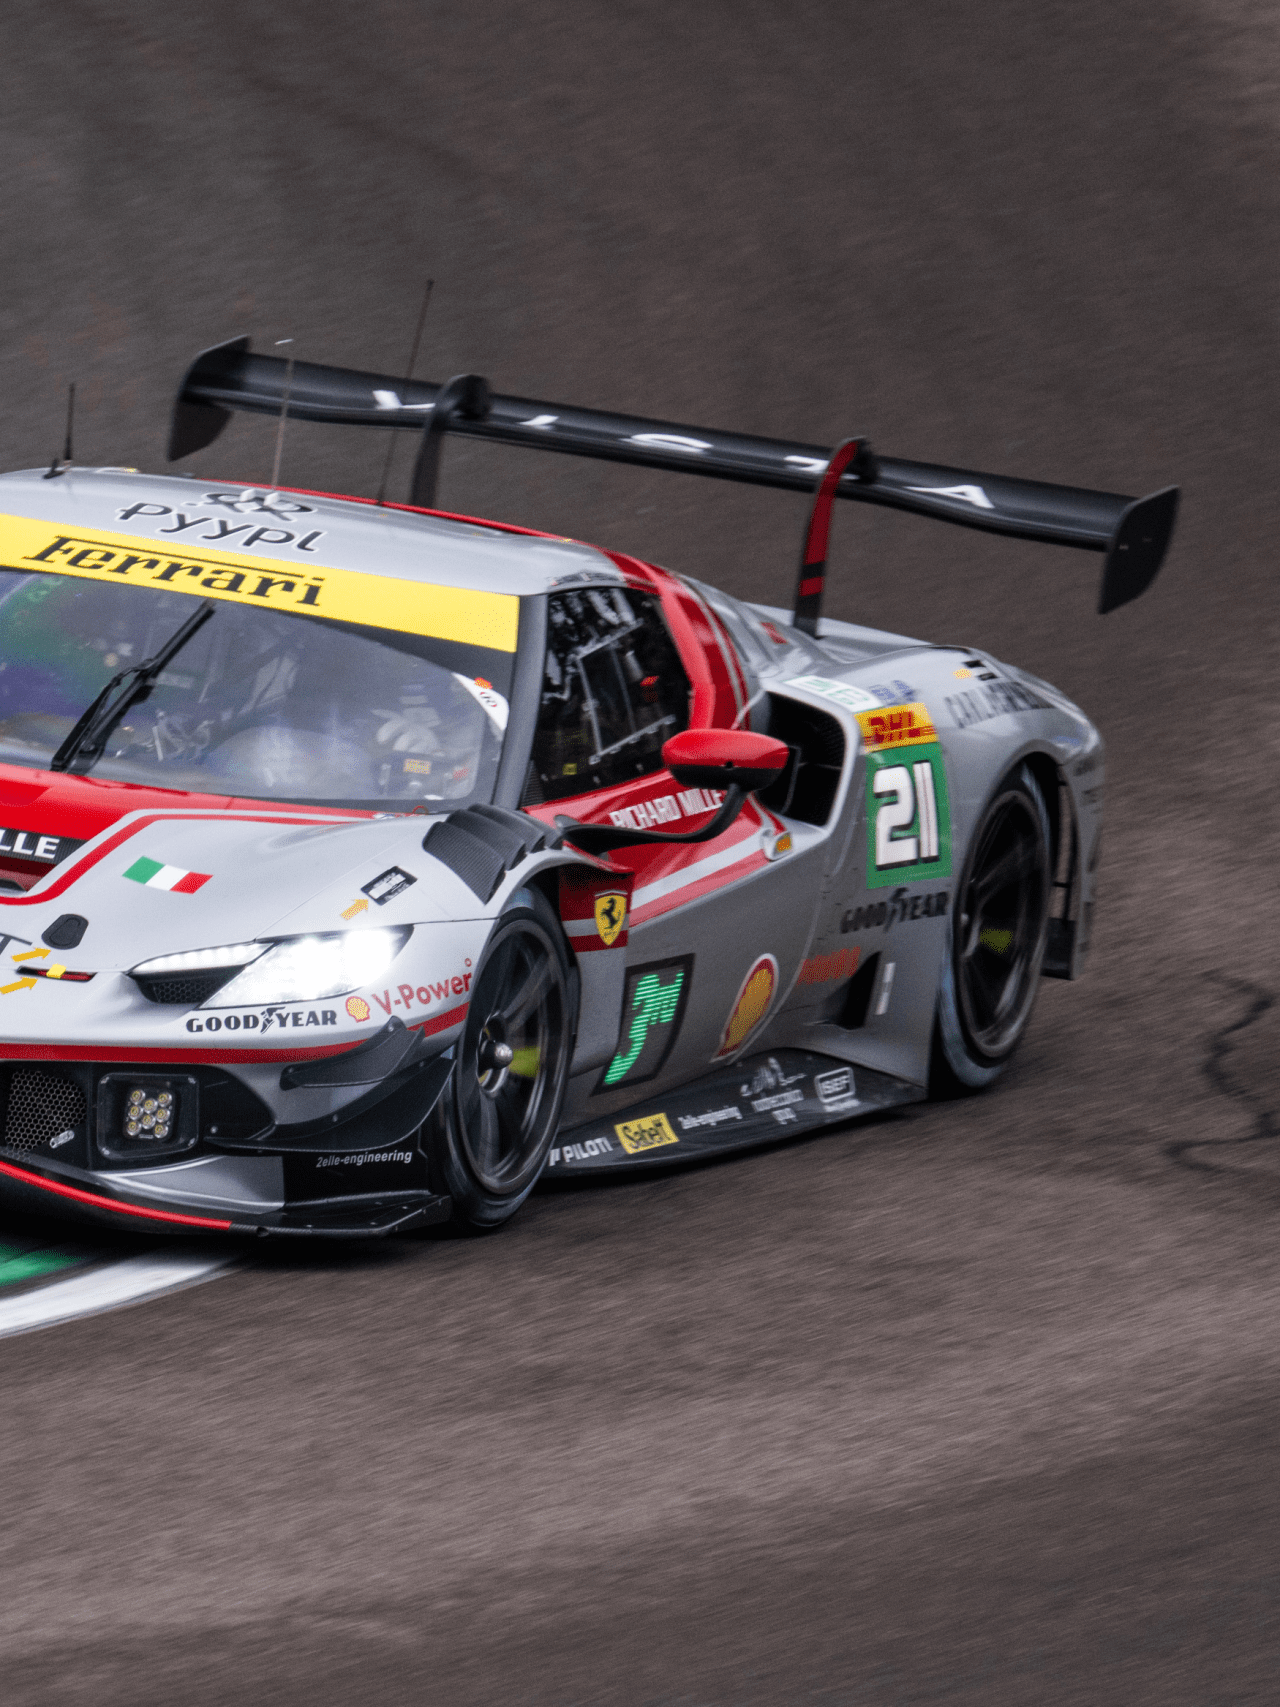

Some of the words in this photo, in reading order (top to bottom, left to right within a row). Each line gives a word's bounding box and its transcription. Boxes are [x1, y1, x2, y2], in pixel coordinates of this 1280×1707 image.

[119, 502, 324, 552] pyypl
[21, 535, 326, 608] Ferrari
[872, 761, 941, 872] 21
[372, 972, 472, 1015] V-Power
[186, 1007, 337, 1034] GOODYEAR
[562, 1137, 613, 1163] PILOTI
